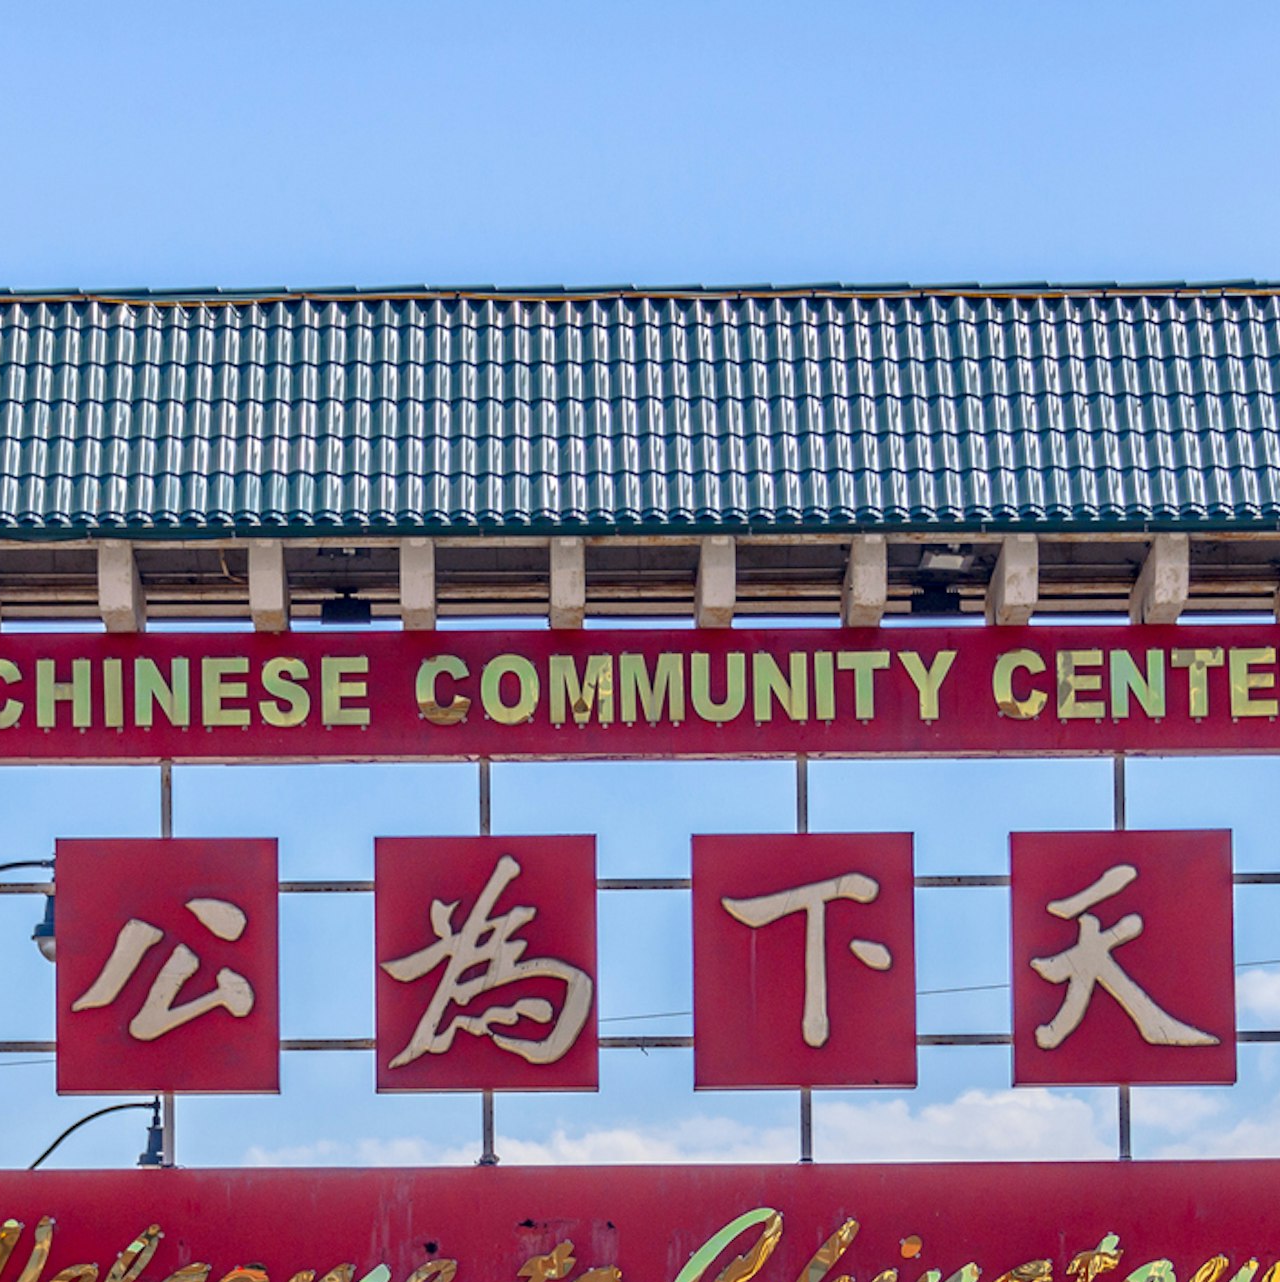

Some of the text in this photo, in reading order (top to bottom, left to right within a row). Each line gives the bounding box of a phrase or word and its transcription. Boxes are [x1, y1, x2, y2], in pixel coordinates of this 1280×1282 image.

[414, 649, 956, 729] COMMUNITY
[73, 897, 255, 1042] 公
[722, 872, 893, 1048] 下
[1029, 864, 1221, 1050] 天
